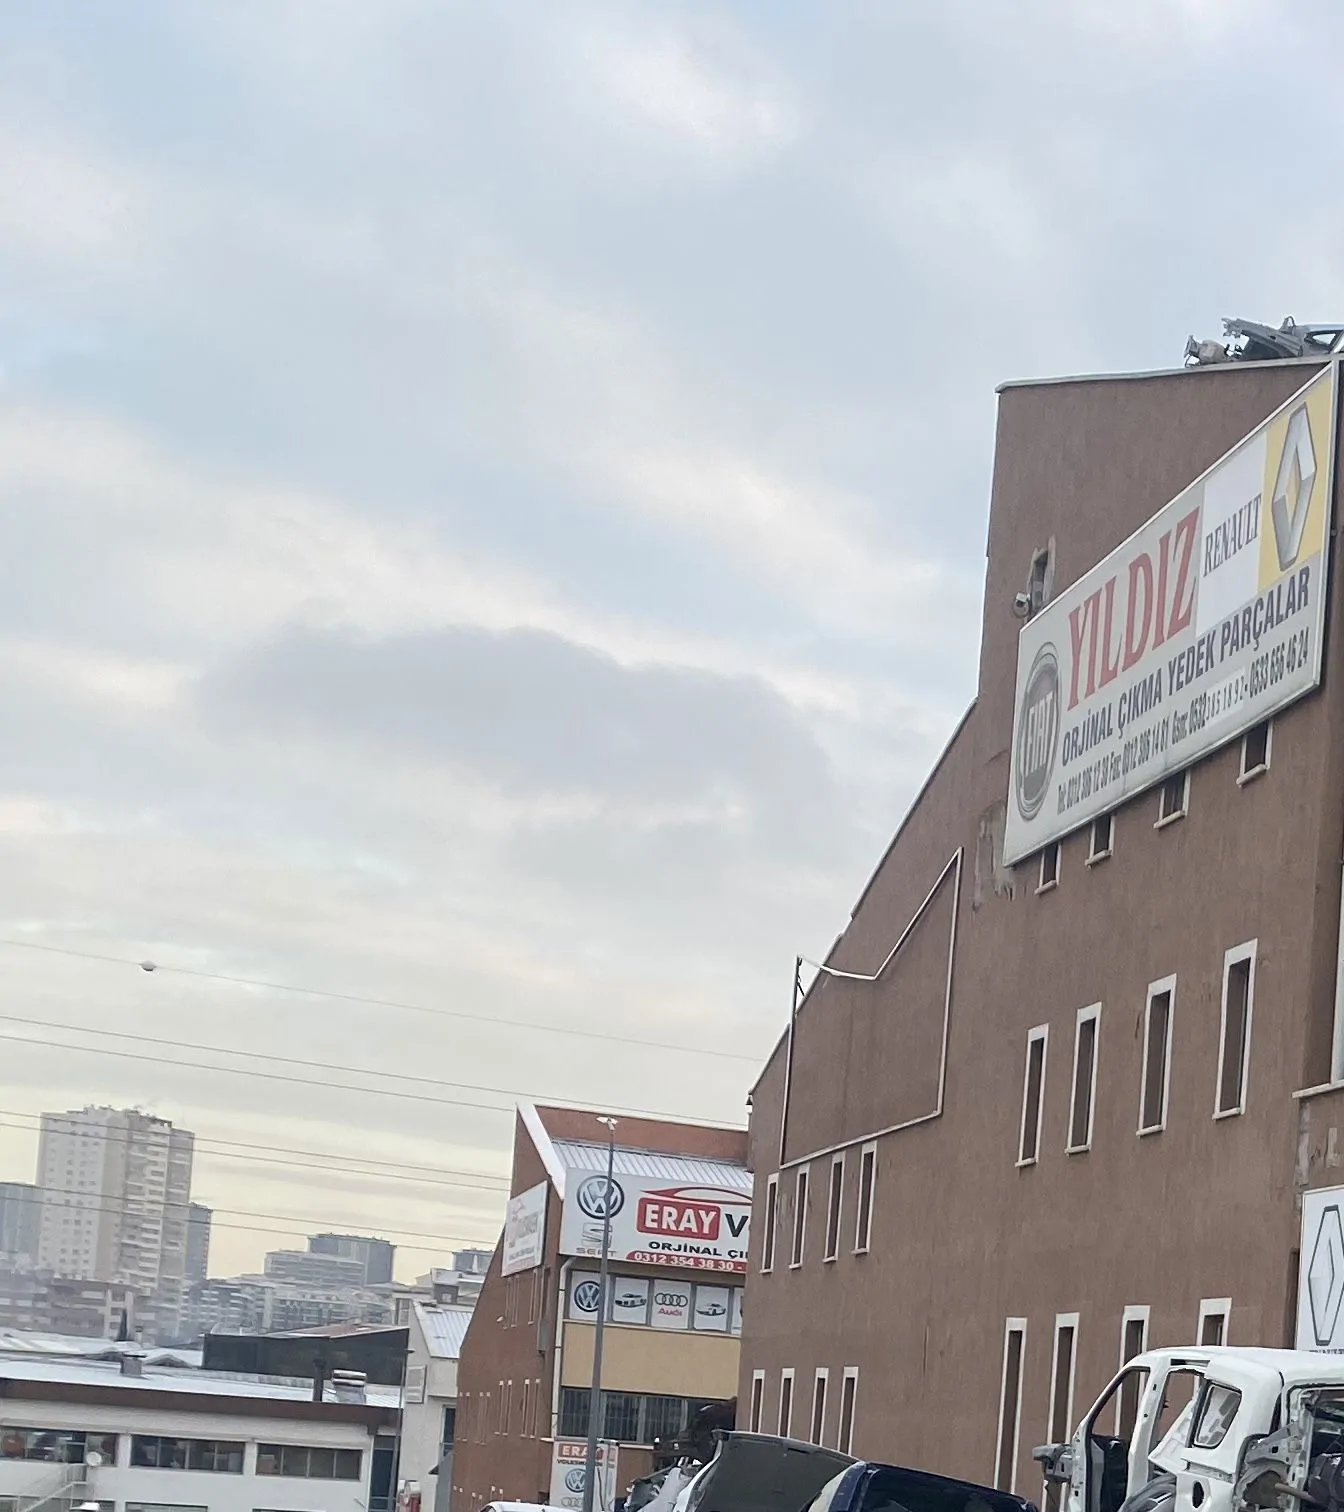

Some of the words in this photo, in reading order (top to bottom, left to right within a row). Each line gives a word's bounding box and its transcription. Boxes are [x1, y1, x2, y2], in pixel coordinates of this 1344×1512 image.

[1203, 493, 1262, 578] RENAULT
[1067, 506, 1200, 711] YILDIZ
[1062, 703, 1113, 766] ORJİNAL
[1118, 667, 1162, 739] ÇIKMA
[1168, 630, 1216, 696] YEDEK
[1220, 566, 1310, 662] PARÇALAR
[1250, 652, 1269, 698] 0533
[1270, 642, 1285, 685] 656
[1286, 633, 1297, 674] 46
[1298, 626, 1310, 668] 24
[645, 1203, 717, 1235] ERAY
[634, 1251, 666, 1265] 0312
[670, 1254, 695, 1267] 354
[718, 1260, 734, 1270] 30
[648, 1241, 722, 1257] ORJİNAL
[658, 1308, 683, 1317] Audi
